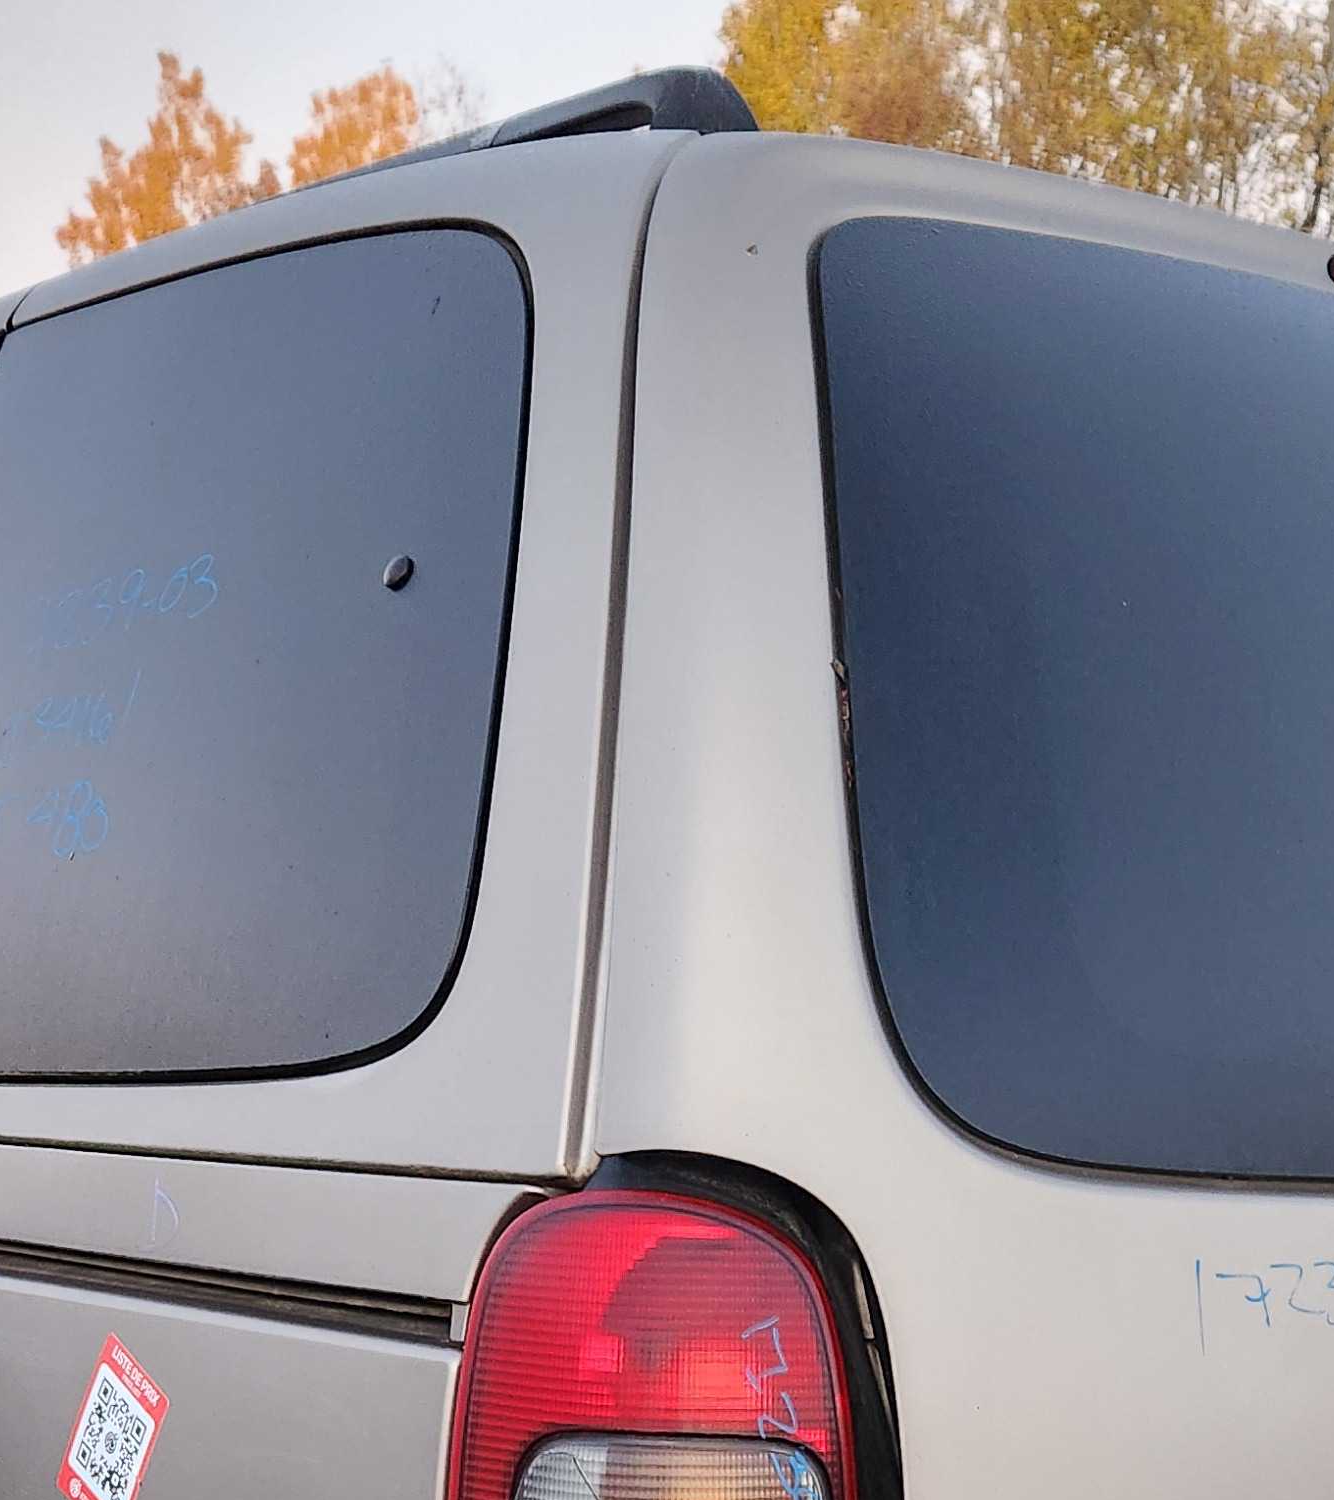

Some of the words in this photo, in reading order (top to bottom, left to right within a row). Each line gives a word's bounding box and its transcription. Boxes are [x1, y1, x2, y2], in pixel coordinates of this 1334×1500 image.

[112, 1345, 136, 1377] LISTE
[131, 1368, 147, 1391] DE
[140, 1375, 161, 1407] PRIX
